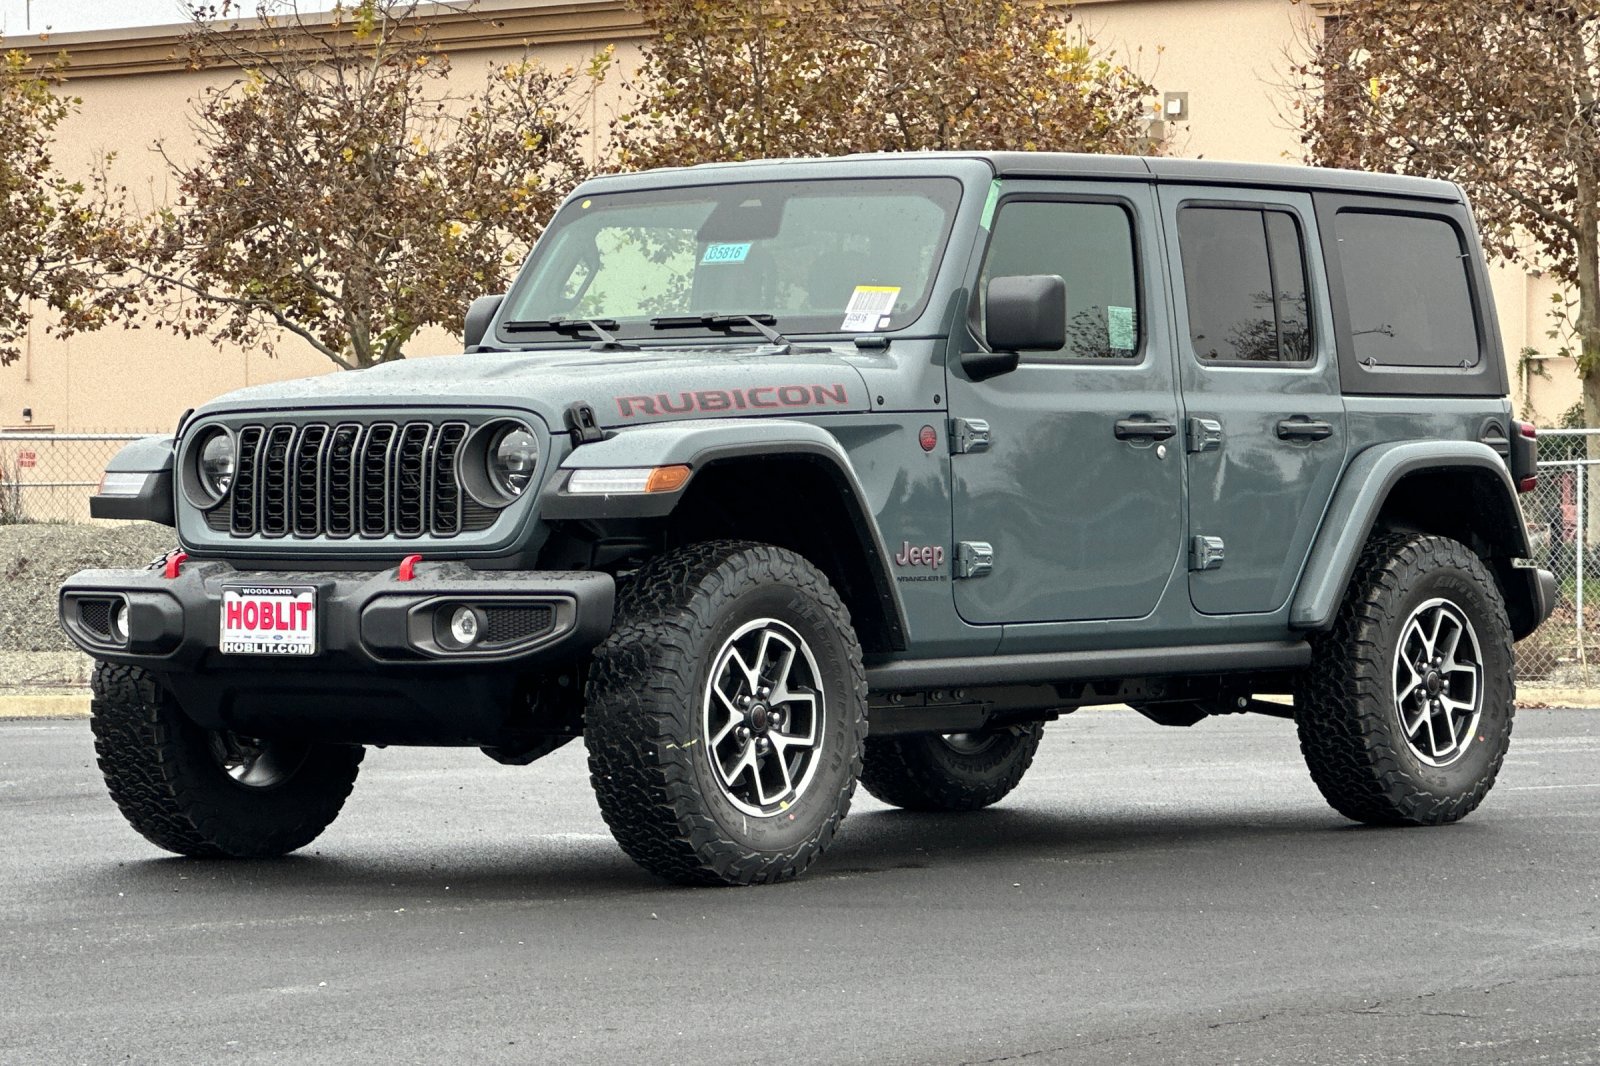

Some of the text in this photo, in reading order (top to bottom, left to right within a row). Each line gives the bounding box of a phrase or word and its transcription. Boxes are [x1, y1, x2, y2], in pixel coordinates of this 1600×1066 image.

[615, 384, 848, 417] RUBICON
[896, 541, 944, 570] Jeep
[227, 601, 311, 630] HOBLIT
[224, 643, 310, 654] HOBLIT.COM
